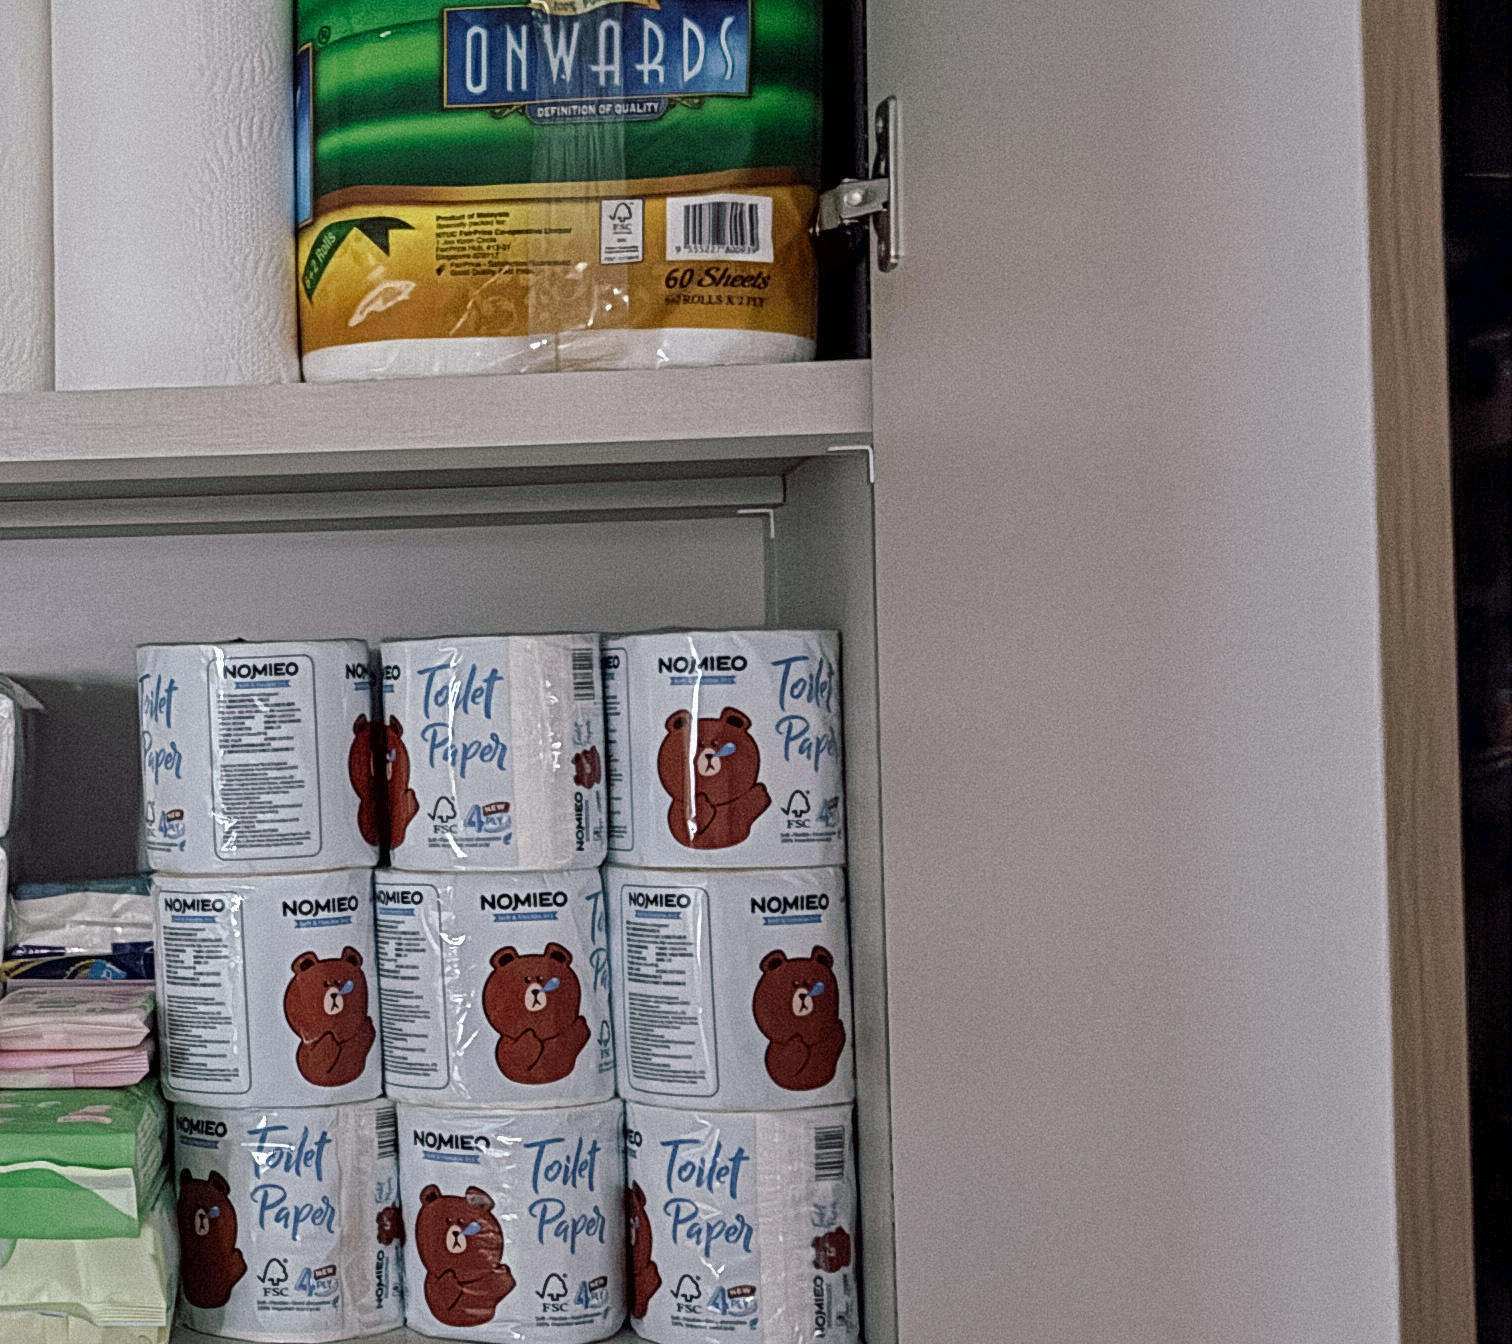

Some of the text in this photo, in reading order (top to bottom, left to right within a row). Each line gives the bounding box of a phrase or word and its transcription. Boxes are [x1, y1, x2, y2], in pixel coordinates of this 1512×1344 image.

[464, 16, 735, 96] ONWARDS
[537, 102, 660, 118] DEFINITION OF QUALITY
[665, 267, 771, 290] 60 Sheets
[223, 661, 299, 680] NOMIEO
[421, 721, 508, 779] Paper
[573, 791, 585, 851] NOMIEO
[787, 819, 811, 829] FSC
[164, 897, 226, 914] NOMIEO
[282, 895, 358, 917] NOMIEO
[480, 890, 569, 911] NOMIEO
[628, 892, 692, 910] NOMIEO
[750, 893, 830, 914] NOMIEO
[413, 1129, 491, 1152] NOMIEO
[247, 1124, 332, 1182] Toilet
[523, 1136, 601, 1194] Toilet
[660, 1138, 750, 1199] Toilet
[250, 1183, 336, 1241] Paper
[528, 1197, 606, 1255] Paper
[663, 1197, 754, 1258] Paper
[263, 1287, 289, 1297] FSC
[542, 1302, 569, 1313] FSC
[676, 1302, 703, 1314] FSC
